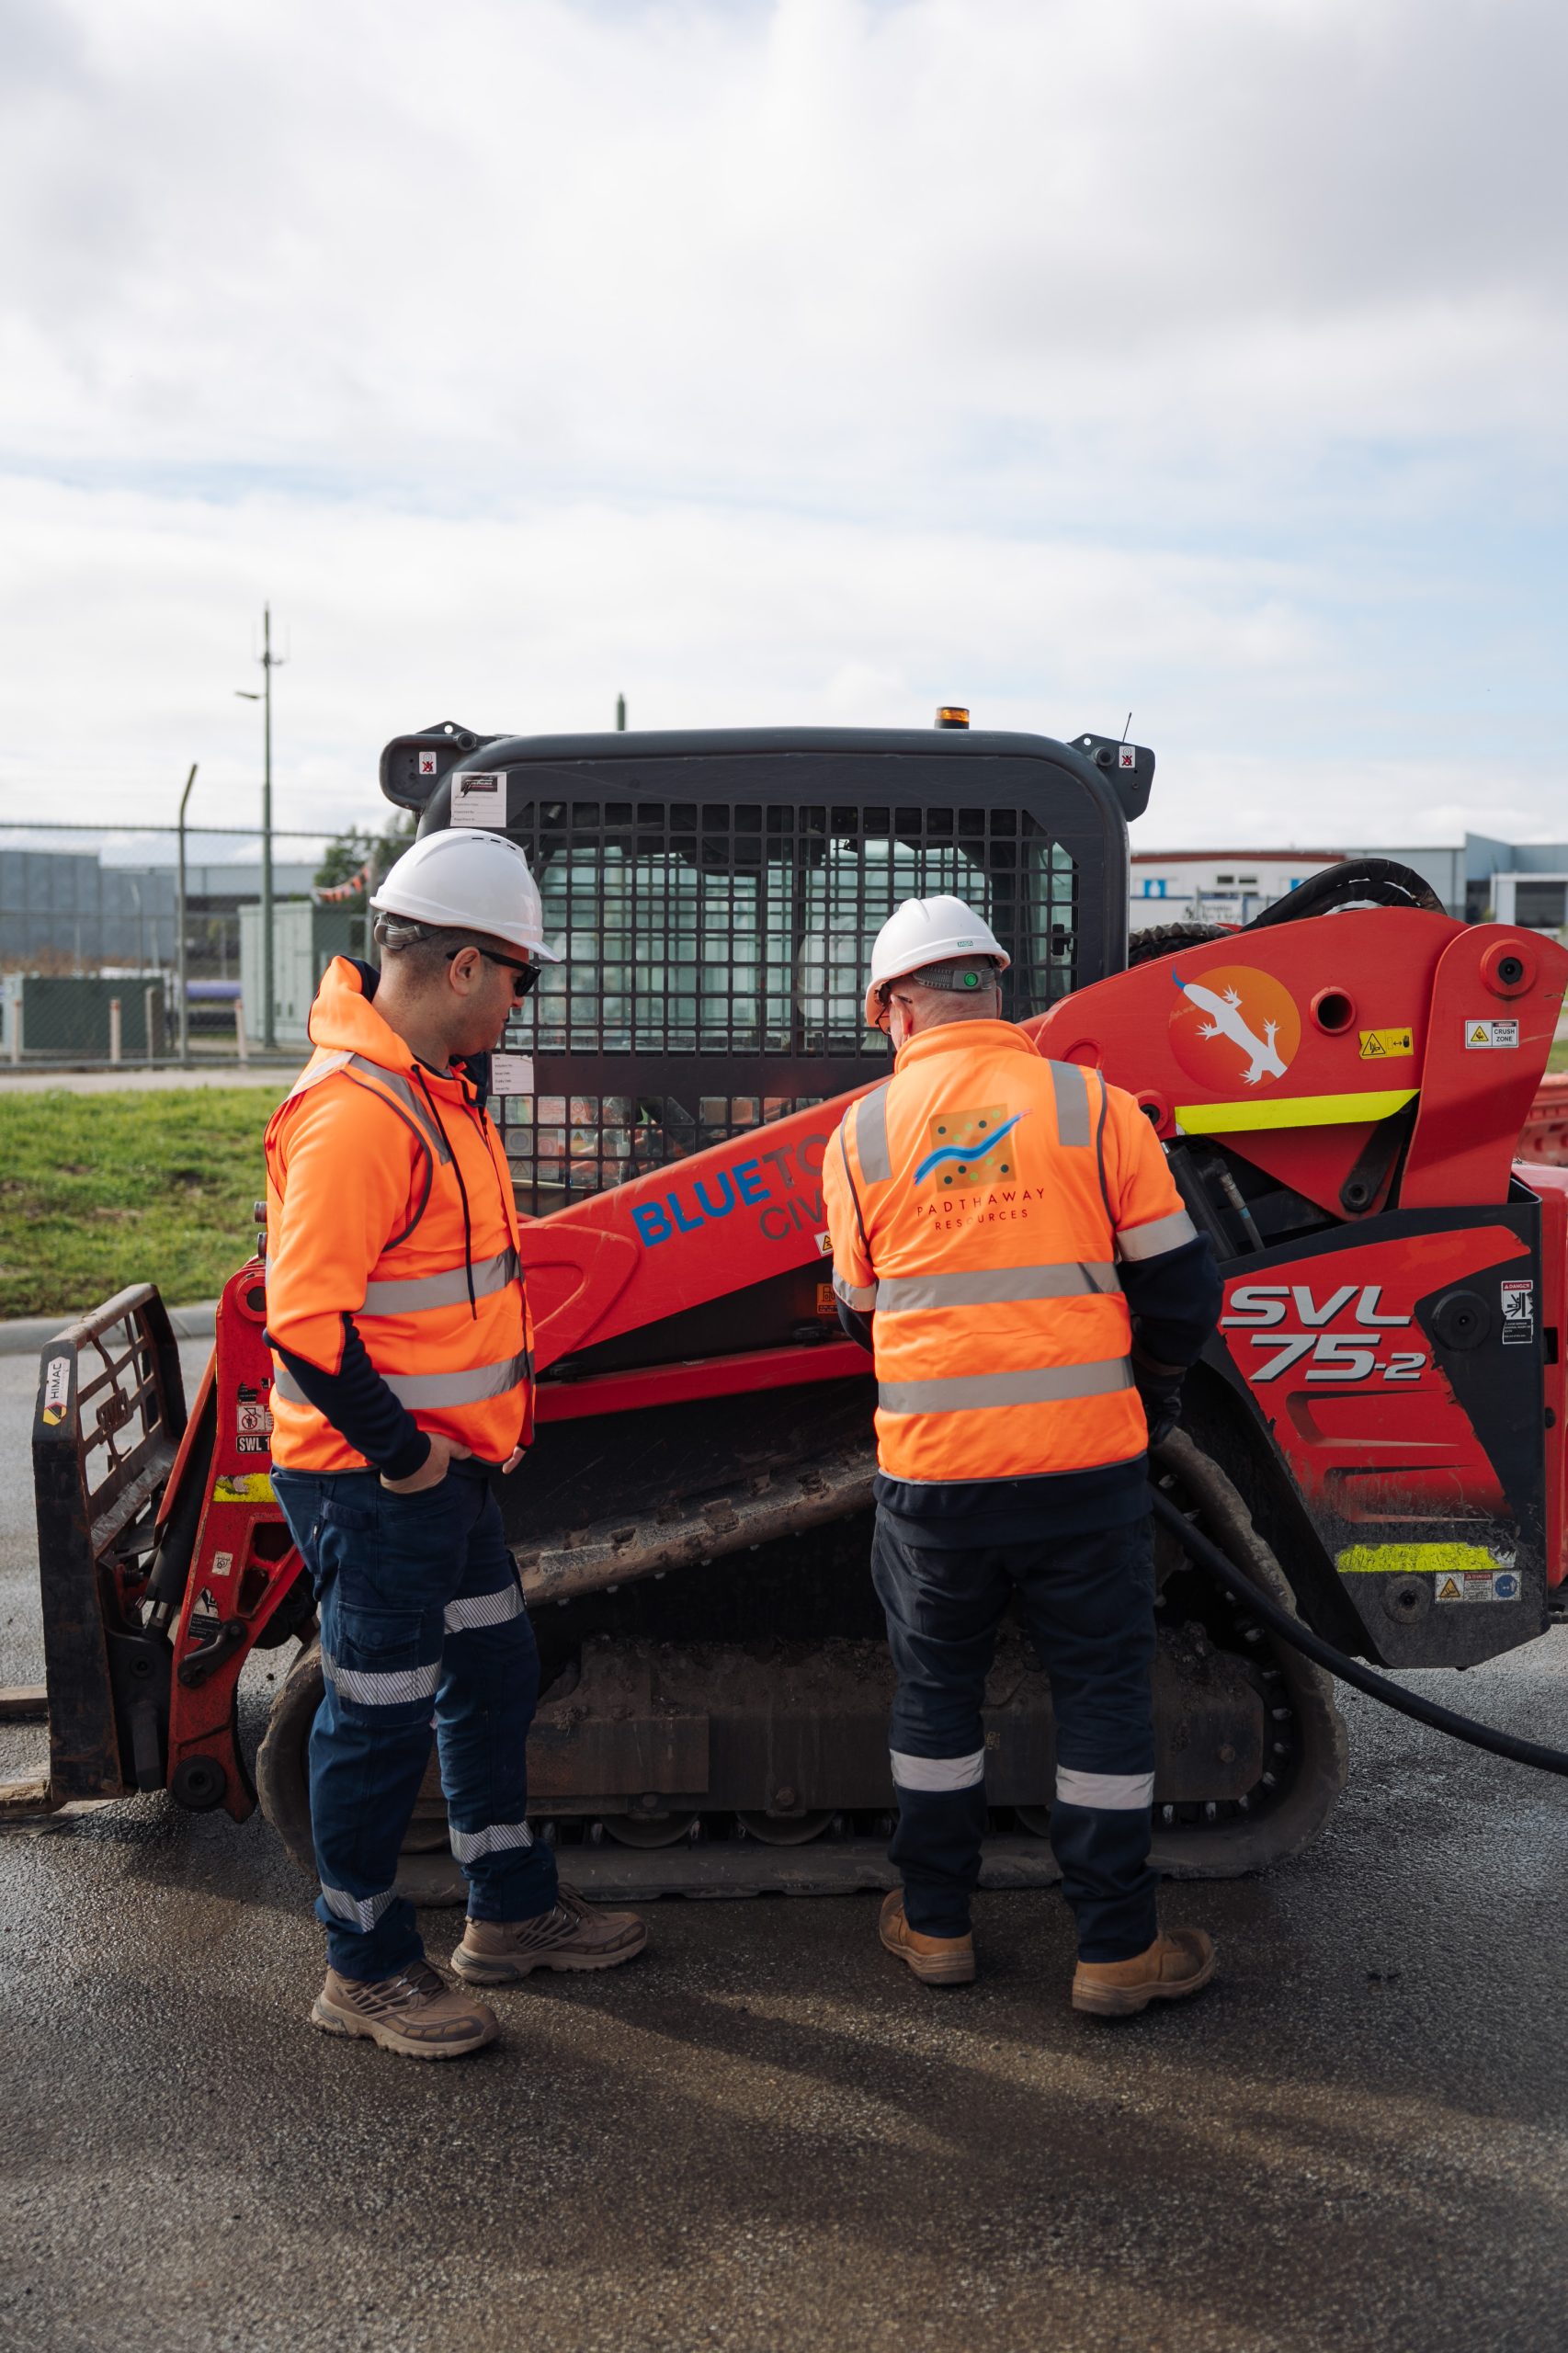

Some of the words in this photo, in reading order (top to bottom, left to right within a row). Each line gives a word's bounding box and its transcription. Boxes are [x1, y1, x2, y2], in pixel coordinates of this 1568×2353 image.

[917, 1188, 1044, 1217] PADTHAWAY
[935, 1209, 1028, 1231] RESOURCES
[1221, 1286, 1412, 1327] SVL
[1249, 1334, 1426, 1381] 75-2
[51, 1363, 62, 1399] HIMAC
[239, 1437, 262, 1451] SWL
